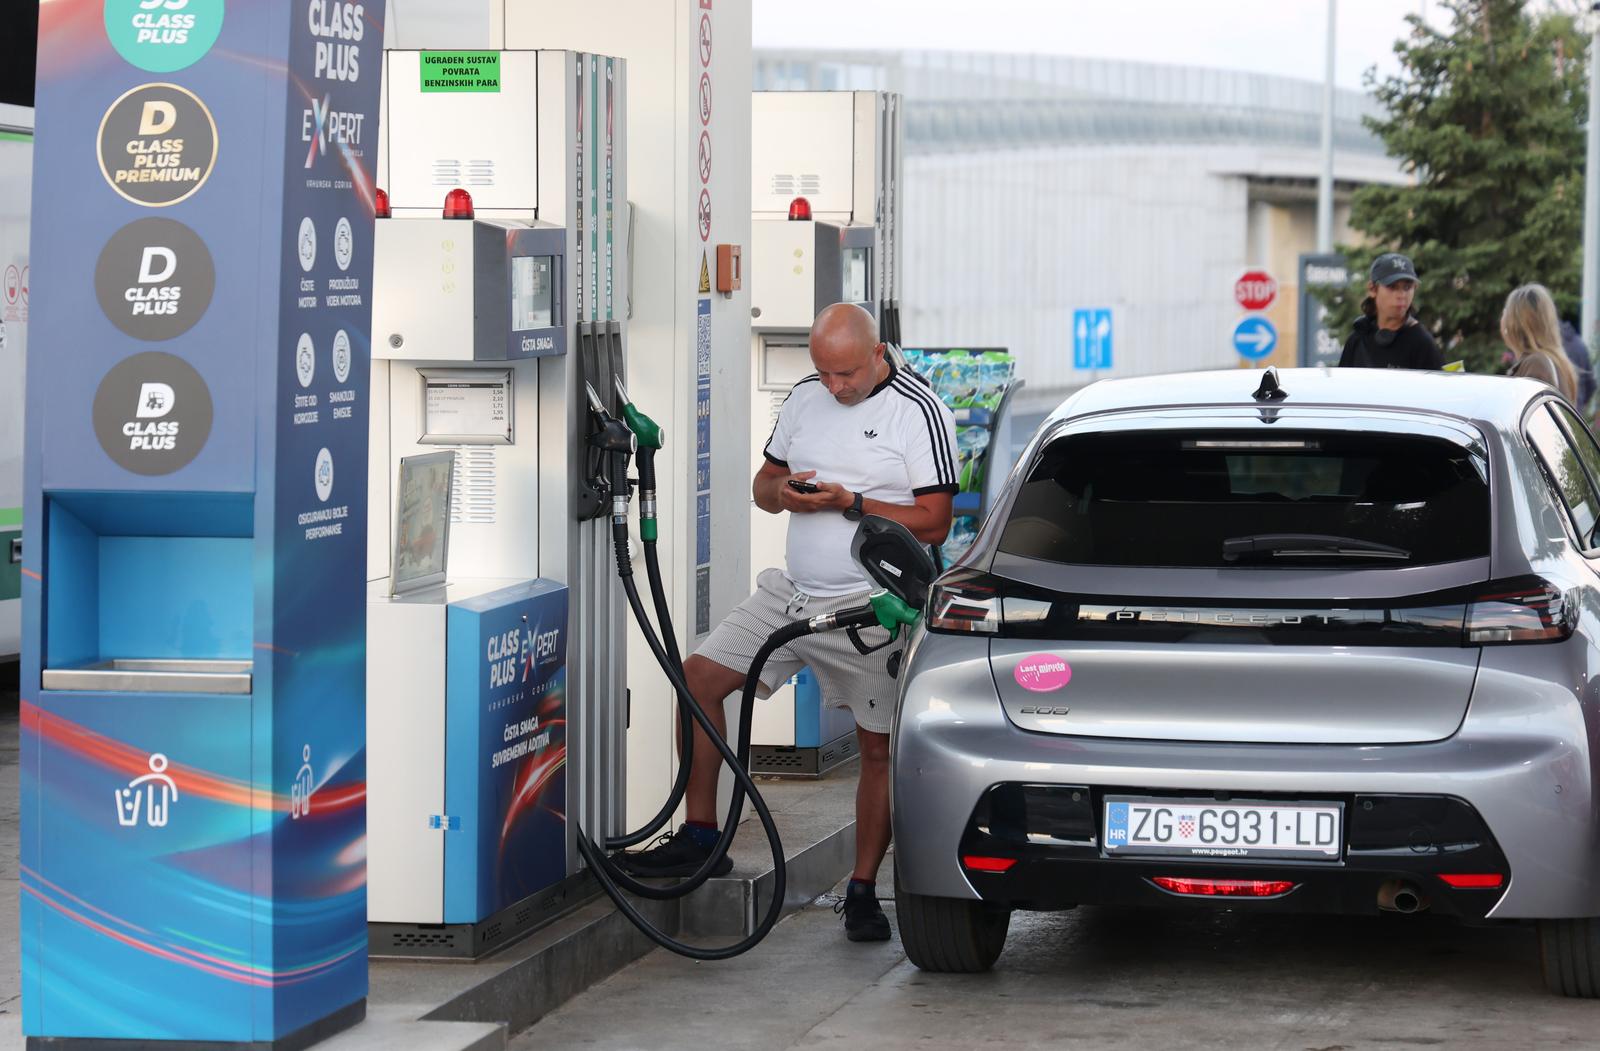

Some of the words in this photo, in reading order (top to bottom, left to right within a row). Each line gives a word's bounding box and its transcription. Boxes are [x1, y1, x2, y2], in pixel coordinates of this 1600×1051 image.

[132, 13, 195, 29] CLASS
[308, 0, 364, 41] CLASS
[137, 28, 188, 44] PLUS
[315, 41, 360, 82] PLUS
[466, 56, 497, 64] SUSTAV
[442, 67, 480, 76] POVRATA
[424, 79, 474, 87] BENZINSKIH
[476, 79, 498, 87] PARA
[138, 100, 177, 135] D
[126, 139, 184, 154] CLASS
[133, 153, 181, 168] PLUS
[114, 167, 201, 183] PREMIUM
[138, 246, 177, 283] D
[124, 286, 181, 301] CLASS
[1236, 279, 1276, 301] STOP
[132, 300, 178, 315] PLUS
[136, 382, 175, 418] D
[122, 421, 179, 436] CLASS
[130, 435, 176, 450] PLUS
[1116, 611, 1336, 625] PEUGEOT
[487, 628, 520, 662] CLASS
[490, 656, 516, 689] PLUS
[1020, 664, 1037, 672] Last
[1020, 705, 1070, 716] 208
[503, 723, 520, 742] ČISTA
[519, 715, 539, 735] SNAGA
[1132, 807, 1174, 843] ZG
[1109, 829, 1126, 840] HR
[1191, 848, 1249, 856] www.peugeot.hr
